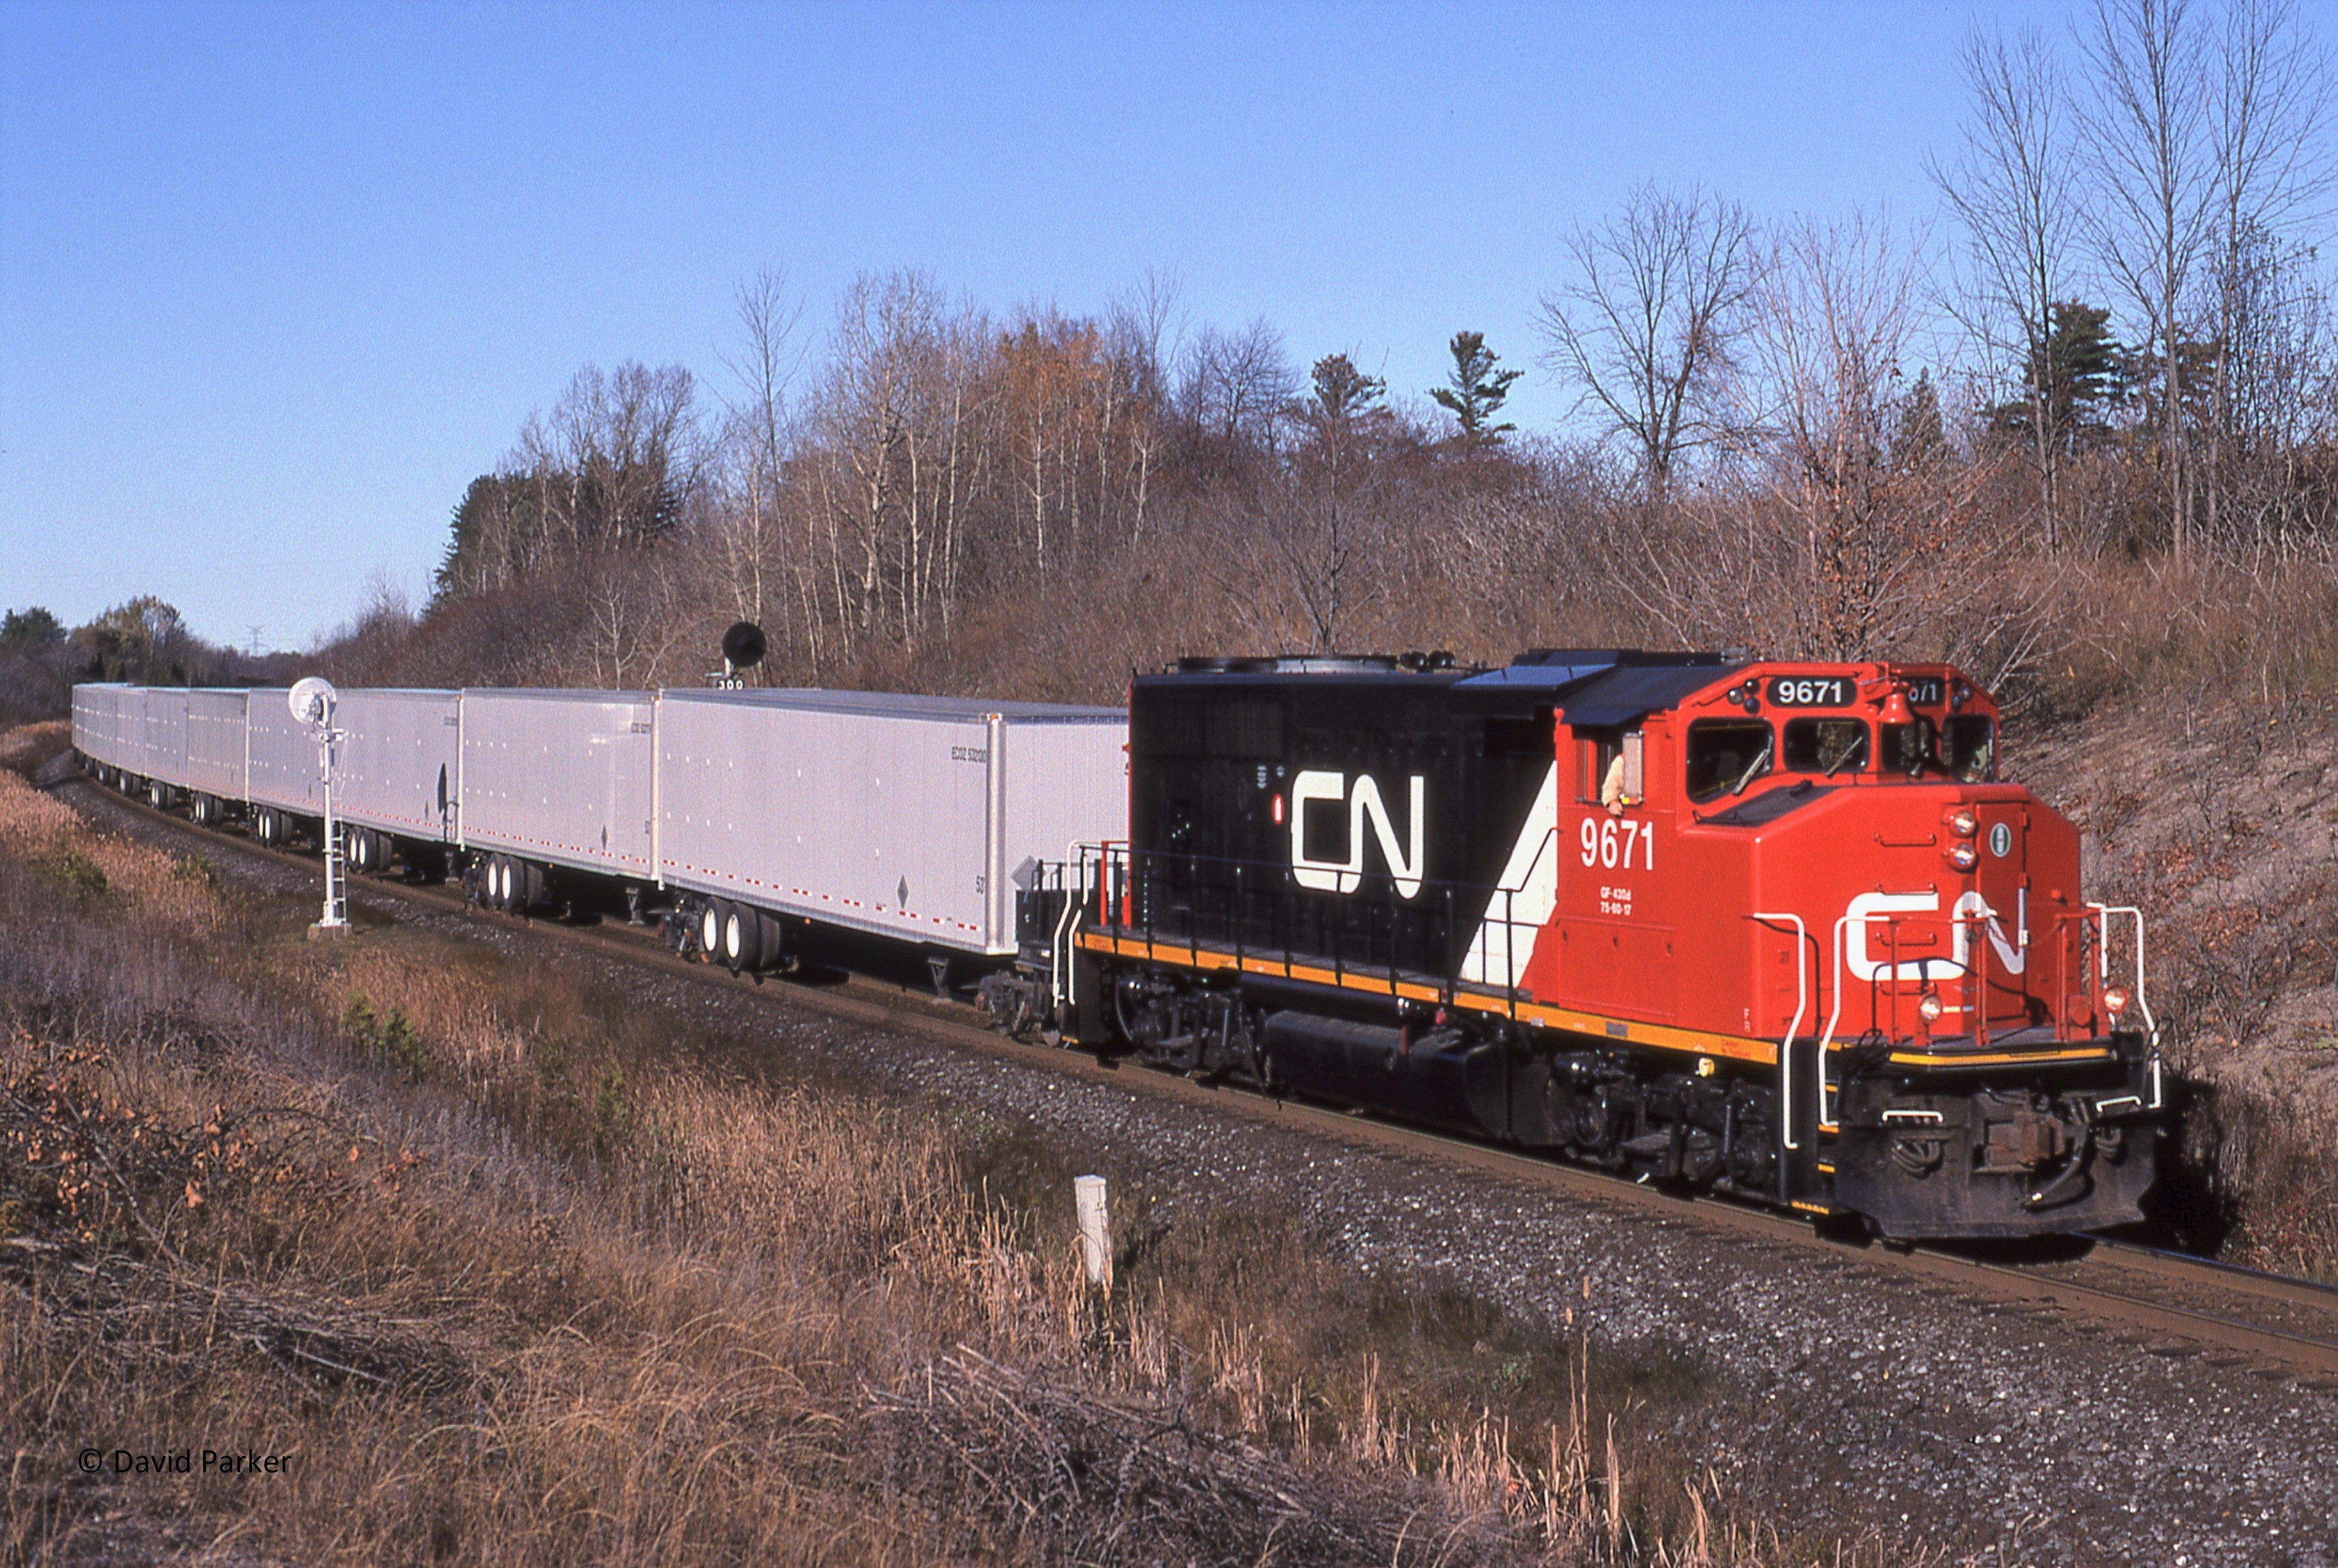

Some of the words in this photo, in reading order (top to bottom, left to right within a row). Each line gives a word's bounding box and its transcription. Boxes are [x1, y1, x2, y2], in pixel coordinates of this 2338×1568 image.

[718, 679, 743, 691] 300
[1778, 680, 1842, 704] 9671
[1291, 771, 1424, 899] CN
[1580, 817, 1653, 871] 9671
[1846, 890, 2025, 981] CN
